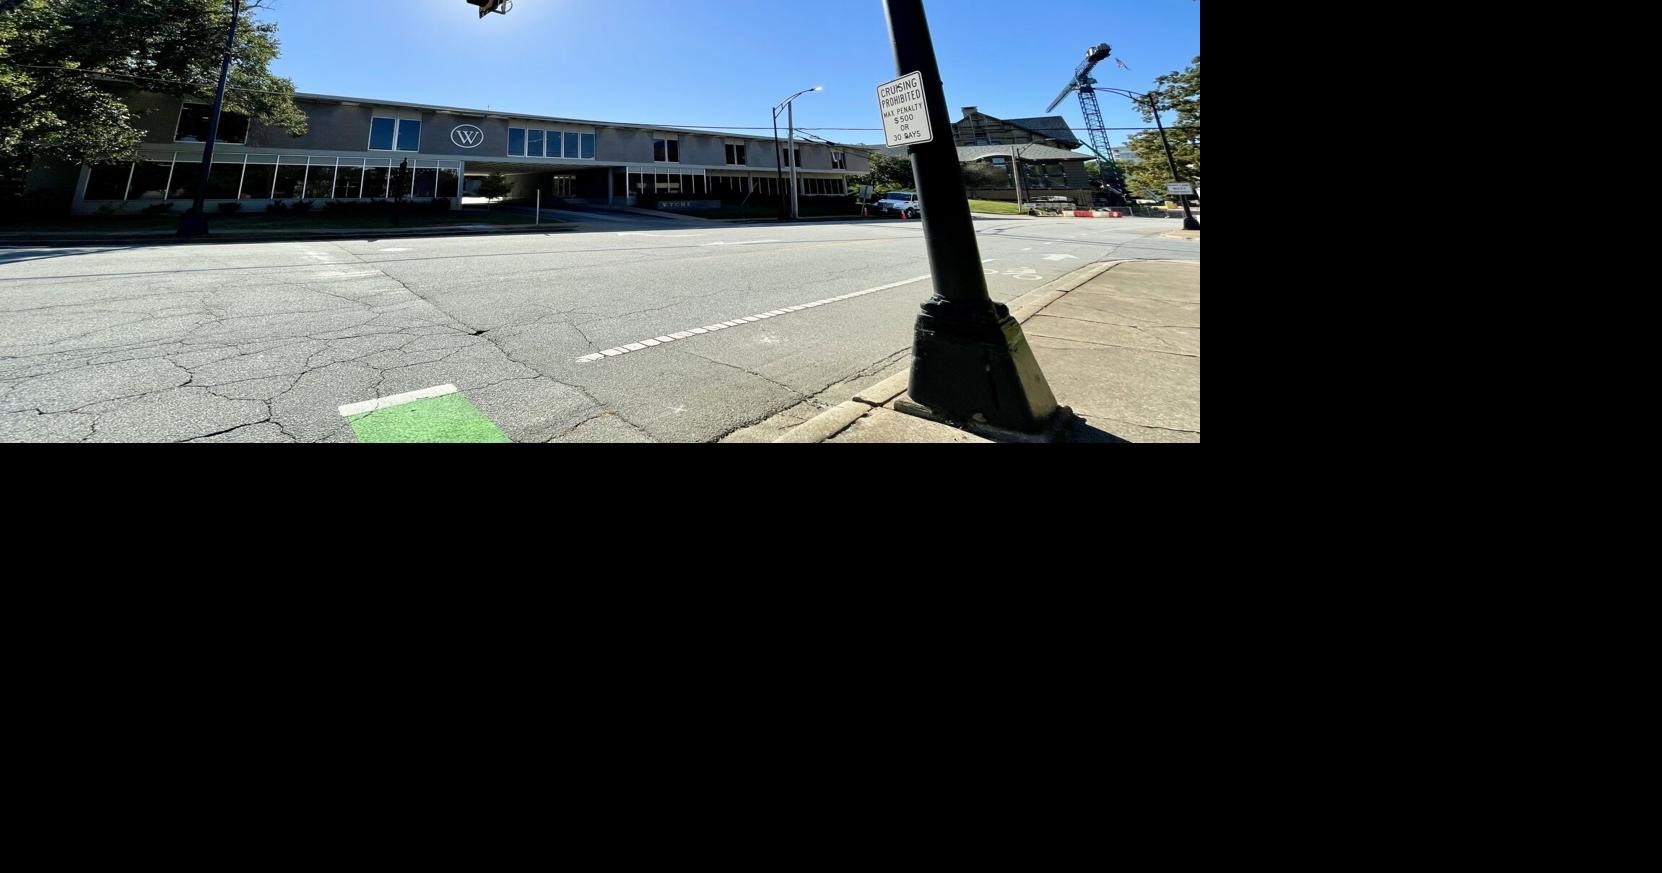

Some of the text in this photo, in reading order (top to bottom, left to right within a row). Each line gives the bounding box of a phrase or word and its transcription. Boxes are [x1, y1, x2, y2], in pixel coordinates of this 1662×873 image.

[881, 78, 917, 97] CRUISING
[882, 89, 921, 109] PROHIBITED
[897, 103, 922, 115] PENALTY
[894, 114, 914, 124] $500
[457, 130, 479, 144] W
[894, 130, 921, 141] 30 DAYS
